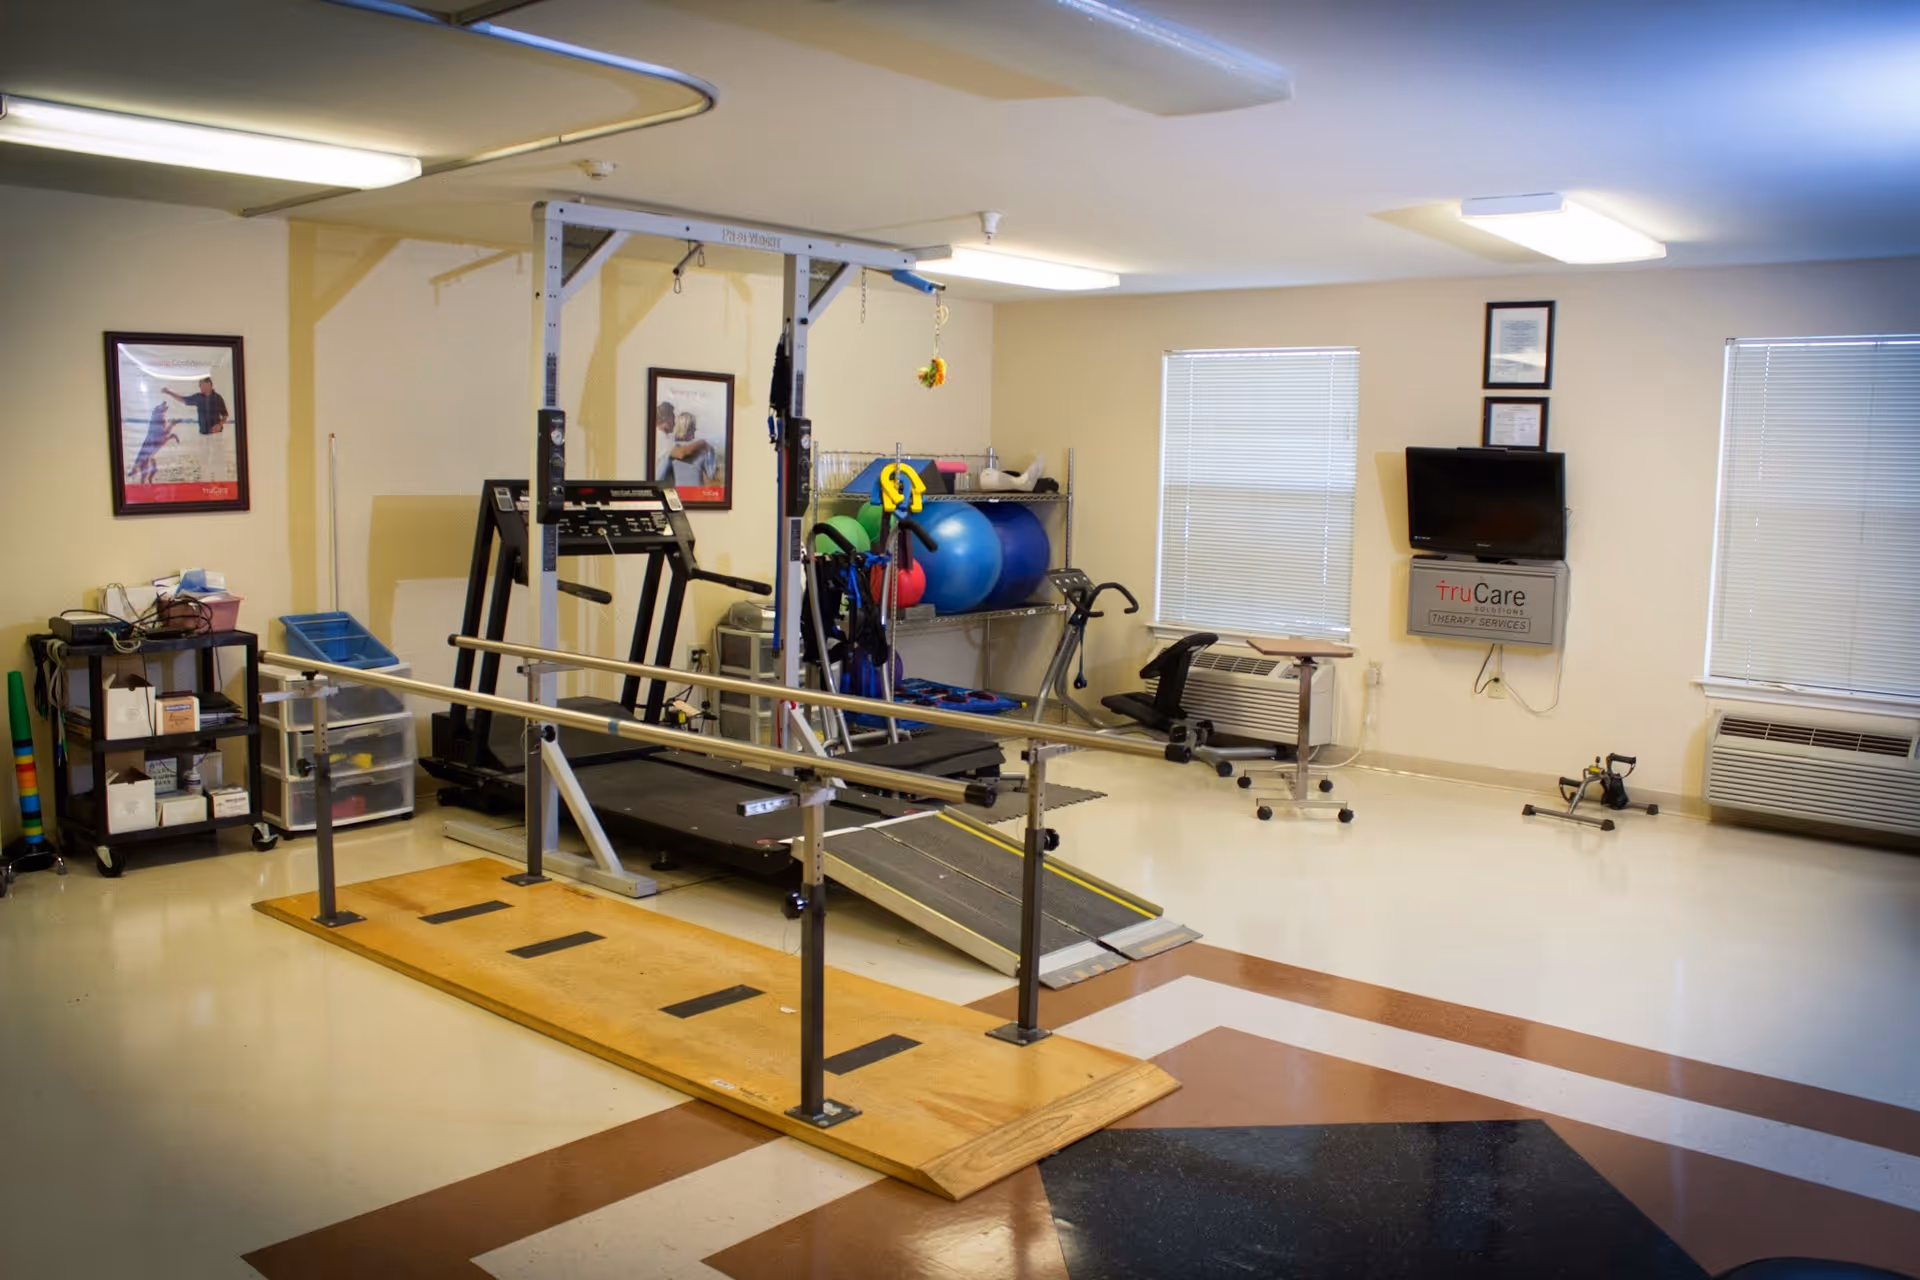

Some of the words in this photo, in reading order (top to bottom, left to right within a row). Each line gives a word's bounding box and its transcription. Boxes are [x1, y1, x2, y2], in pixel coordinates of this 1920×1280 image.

[1474, 606, 1525, 616] SOLUTIONS
[1432, 613, 1476, 625] THERAPY
[1479, 618, 1527, 631] SERVICES
